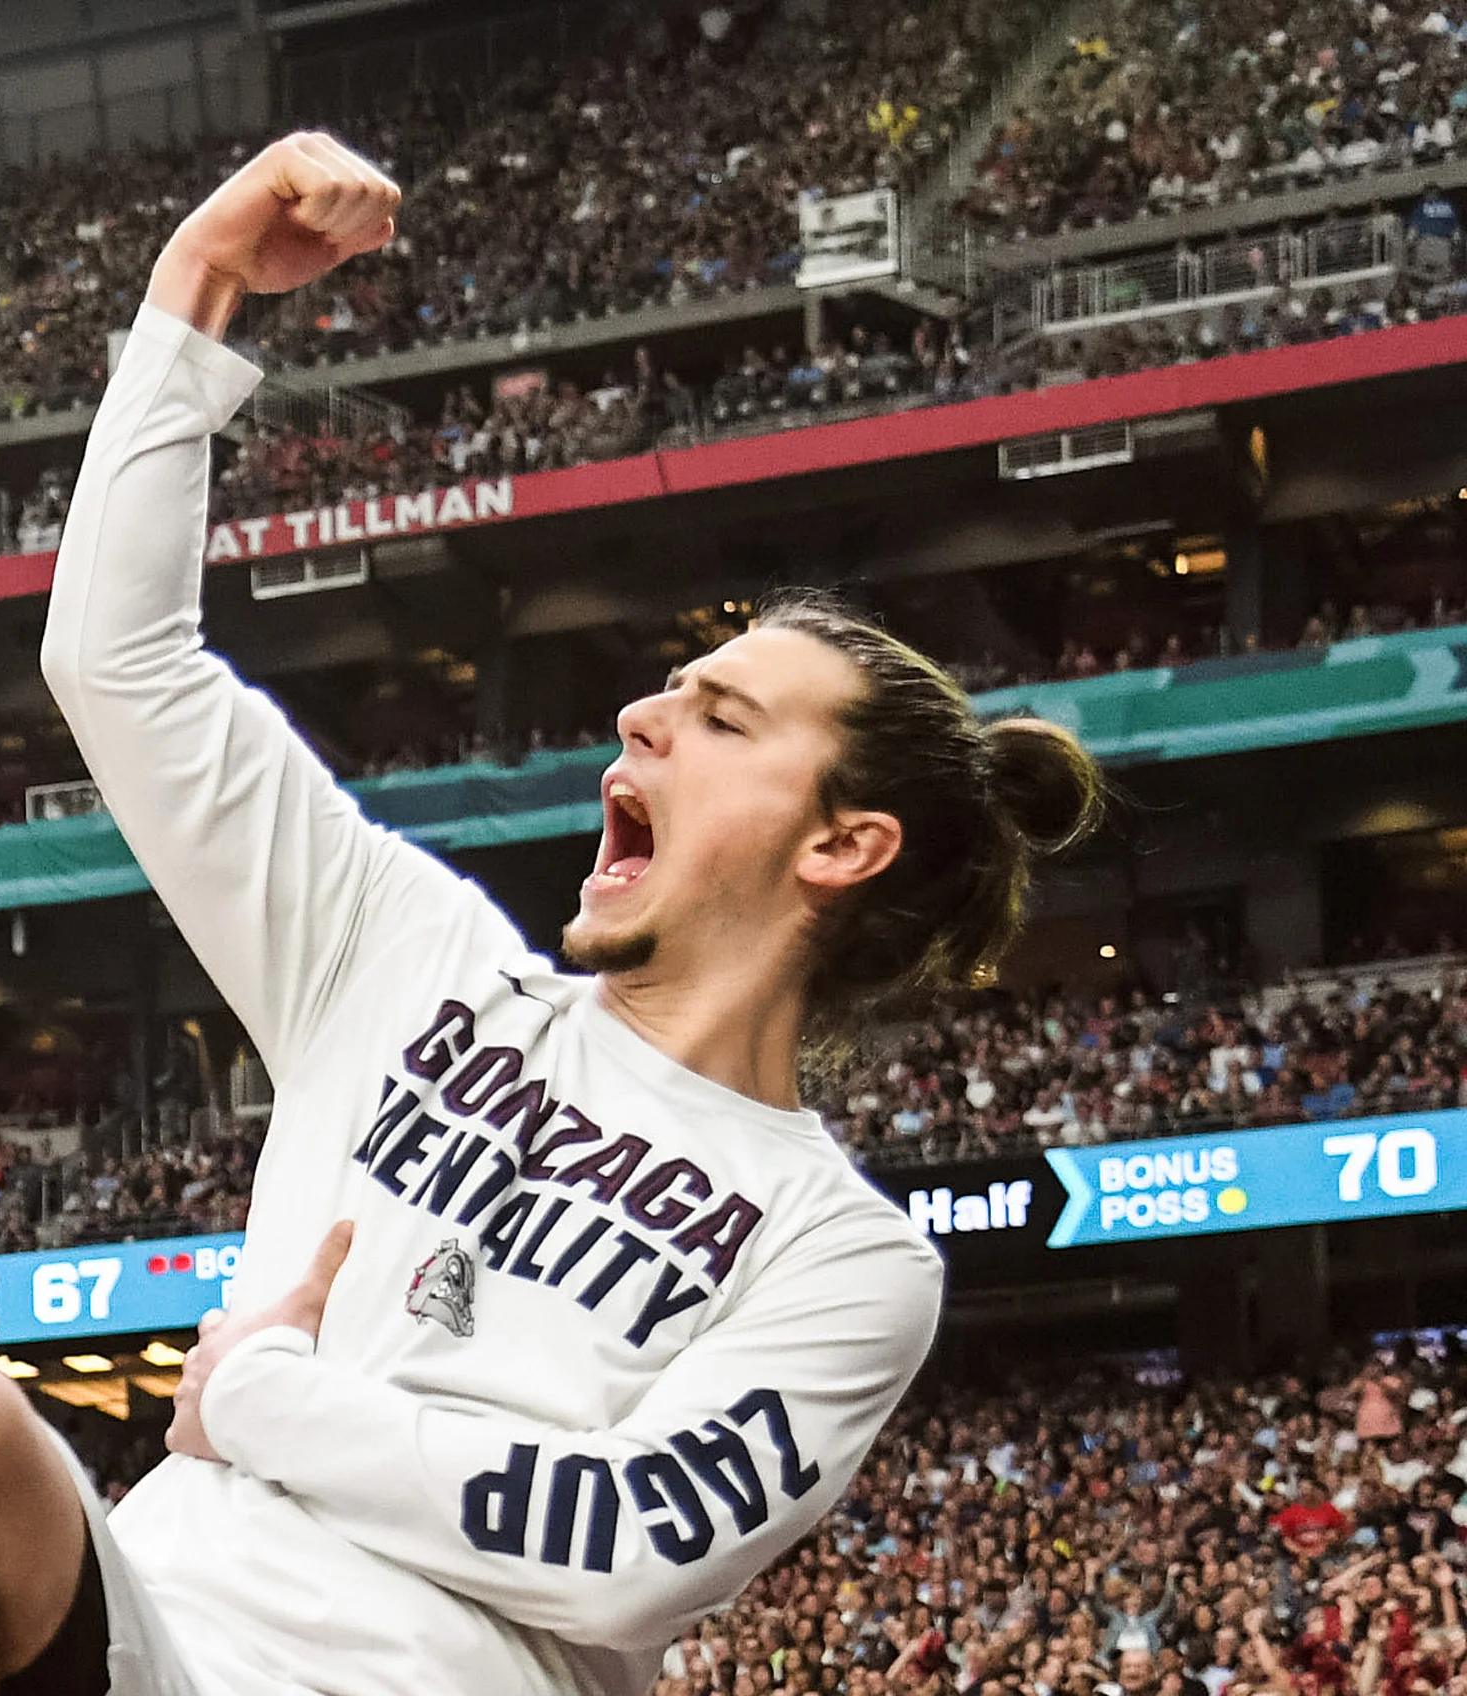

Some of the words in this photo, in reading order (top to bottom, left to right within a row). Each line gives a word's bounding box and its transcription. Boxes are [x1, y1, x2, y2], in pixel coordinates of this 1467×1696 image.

[207, 516, 270, 563] AT
[285, 476, 514, 548] TILLMAN
[402, 1000, 764, 1286] GONZAGA
[1098, 1147, 1238, 1194] BONUS
[1322, 1127, 1438, 1203] 70
[353, 1074, 708, 1349] MENTALITY
[908, 1179, 1033, 1235] Half
[1099, 1188, 1210, 1231] POSS
[32, 1257, 122, 1325] 67
